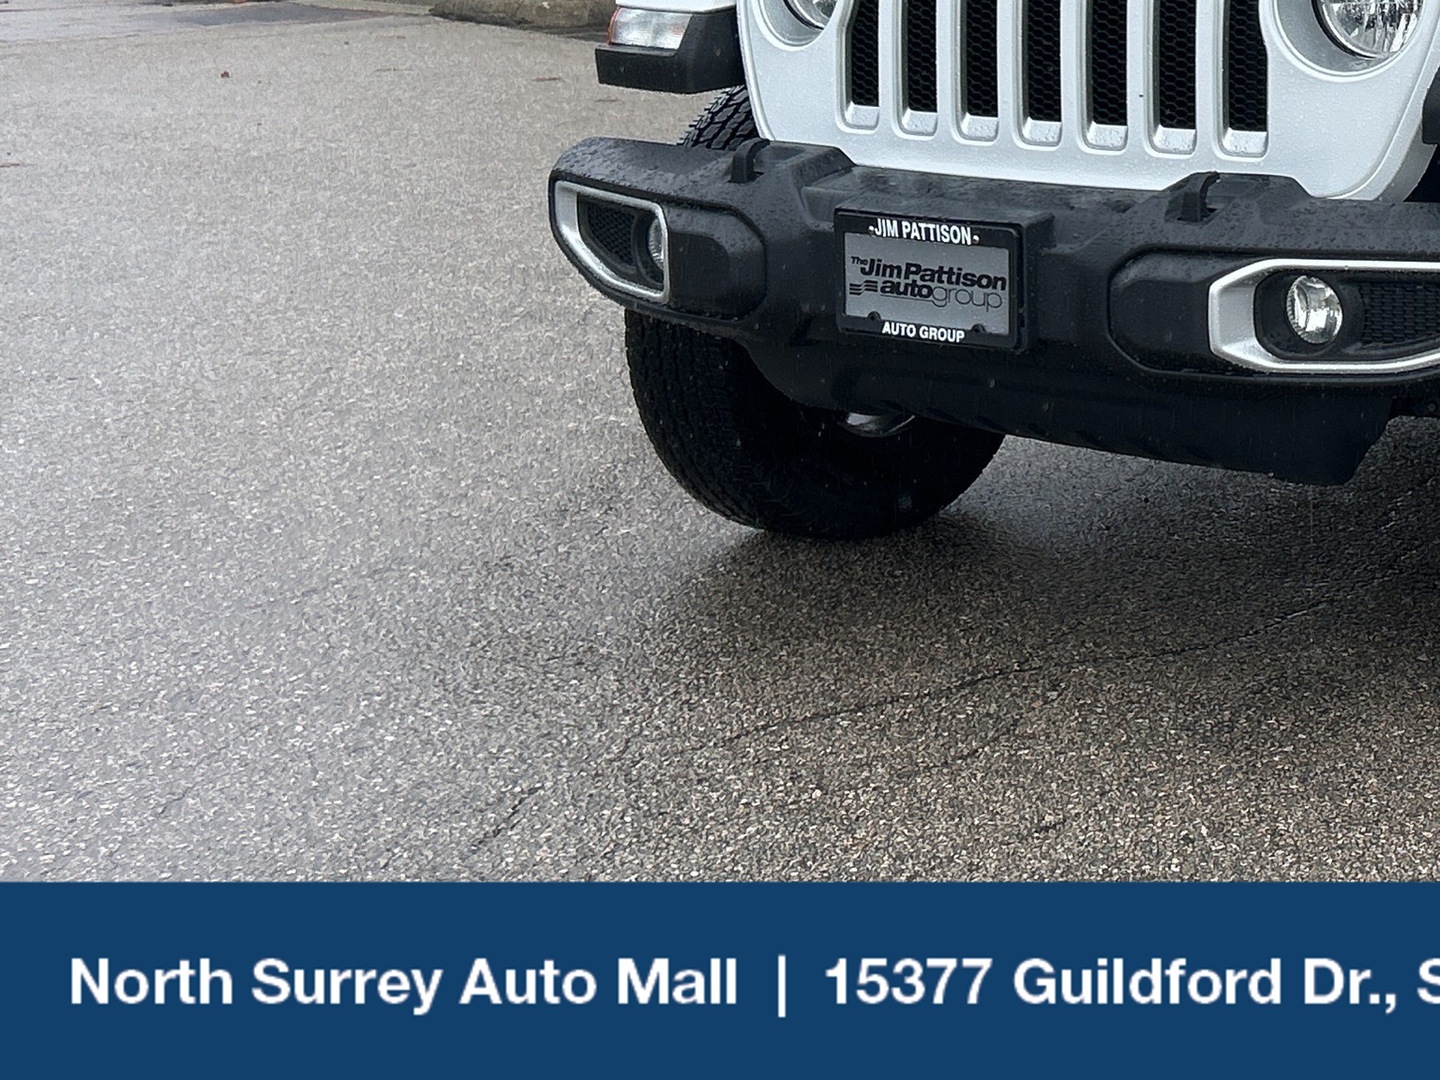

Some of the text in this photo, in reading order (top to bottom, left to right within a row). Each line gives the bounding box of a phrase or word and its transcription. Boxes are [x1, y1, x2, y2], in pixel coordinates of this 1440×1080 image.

[874, 218, 972, 245] JIM PATTISON
[851, 256, 1007, 291] The Jim Pattison
[882, 321, 965, 343] AUTO GROUP
